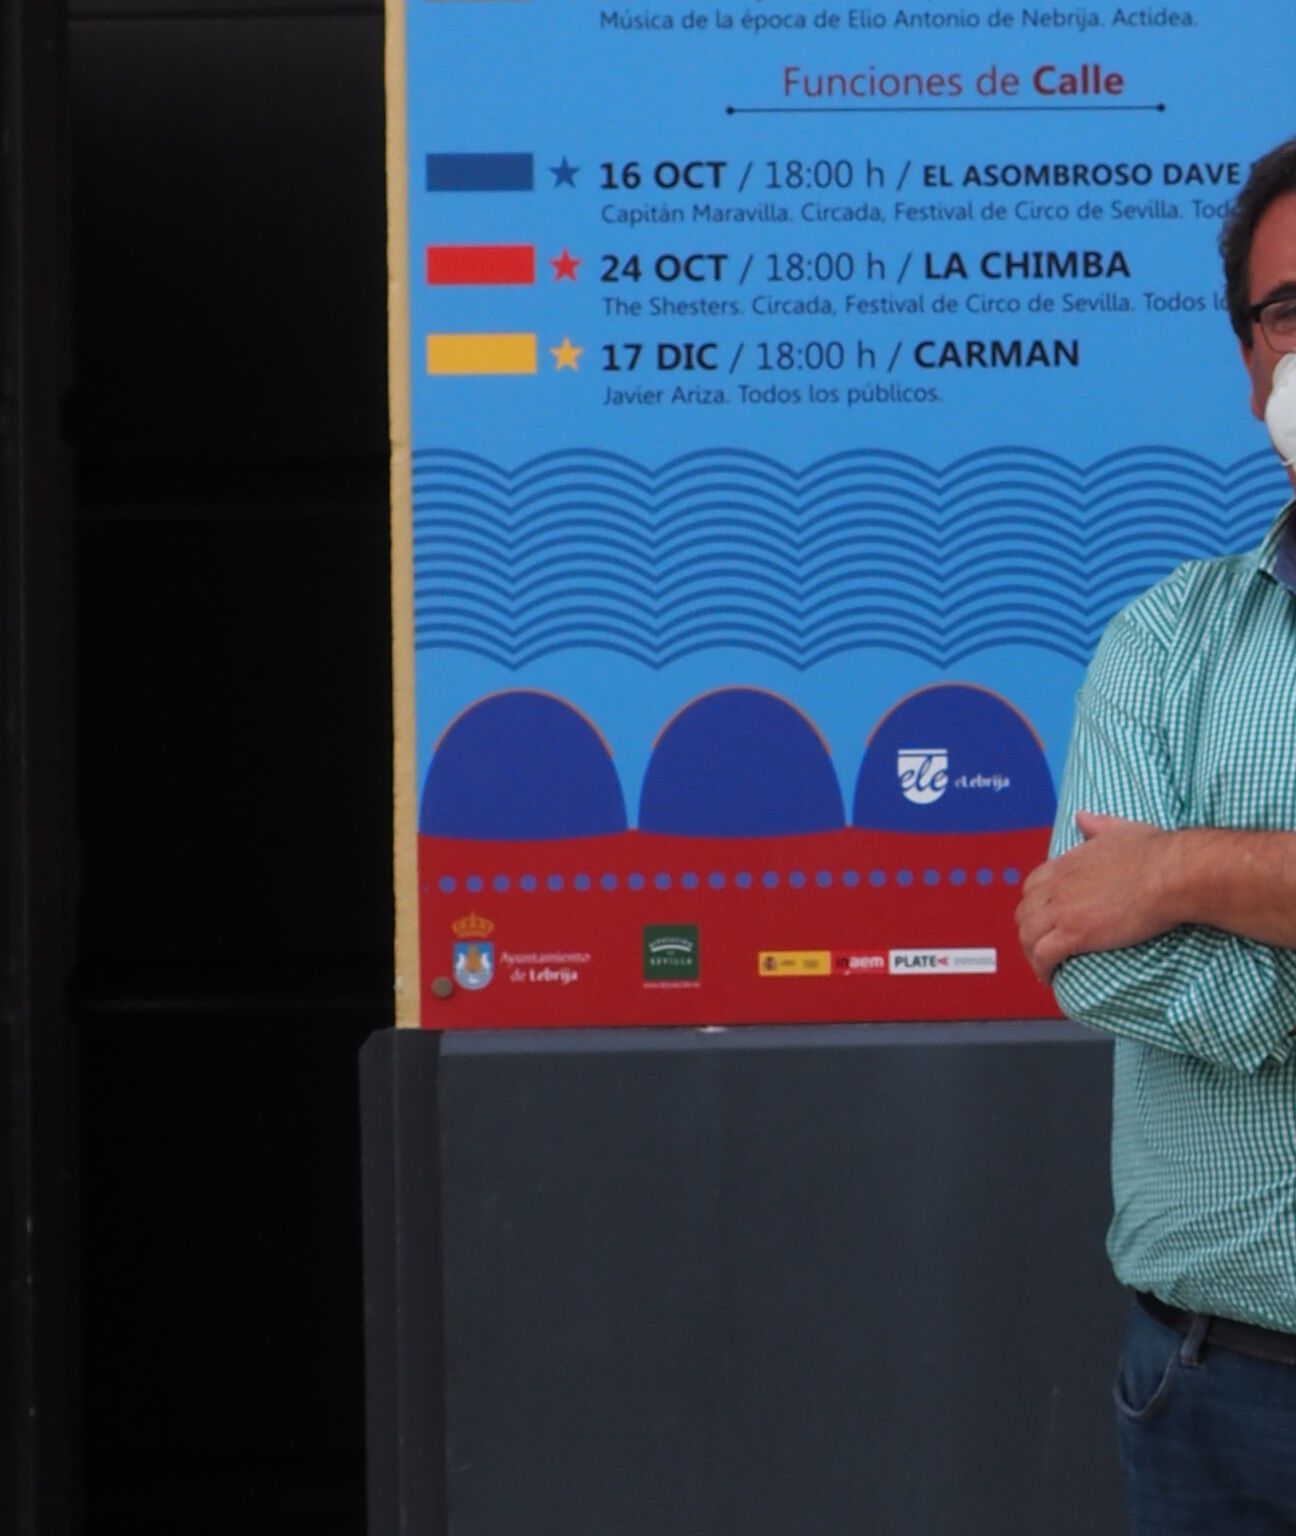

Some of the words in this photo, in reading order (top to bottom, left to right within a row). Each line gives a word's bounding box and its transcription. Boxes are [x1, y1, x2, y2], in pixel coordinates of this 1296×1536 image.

[600, 10, 674, 29] Música
[681, 10, 708, 29] de
[741, 9, 806, 33] época
[813, 9, 840, 29] de
[849, 9, 886, 28] Elio
[894, 10, 980, 28] Antonio
[988, 9, 1014, 27] de
[784, 66, 963, 96] Funciones
[976, 66, 1019, 96] de
[1032, 64, 1124, 96] Calle
[601, 162, 641, 189] 16
[654, 161, 727, 189] OCT
[768, 160, 853, 188] 18:00
[867, 159, 884, 187] h
[924, 165, 953, 187] EL
[963, 163, 1152, 187] ASOMBROSO
[1163, 162, 1240, 185] DAVE
[602, 204, 684, 227] Capitán
[895, 202, 973, 221] Festival
[981, 202, 1007, 220] de
[1015, 201, 1069, 220] Circo
[601, 255, 642, 282] 24
[655, 254, 728, 282] OCT
[768, 253, 853, 281] 18:00
[868, 253, 884, 279] h
[925, 252, 968, 279] LA
[981, 251, 1130, 279] CHIMBA
[603, 297, 642, 316] The
[846, 294, 924, 314] Festival
[932, 295, 958, 313] de
[966, 294, 1020, 313] Circo
[1143, 292, 1206, 311] Todos
[603, 344, 642, 371] 17
[658, 343, 717, 370] DIC
[759, 342, 844, 370] 18:00
[858, 341, 875, 368] h
[914, 340, 1079, 368] CARMAN
[604, 387, 664, 405] Javier
[738, 384, 801, 404] Todos
[809, 385, 839, 403] los
[501, 951, 591, 967] Ayuntamiento
[529, 968, 578, 985] Lebrija
